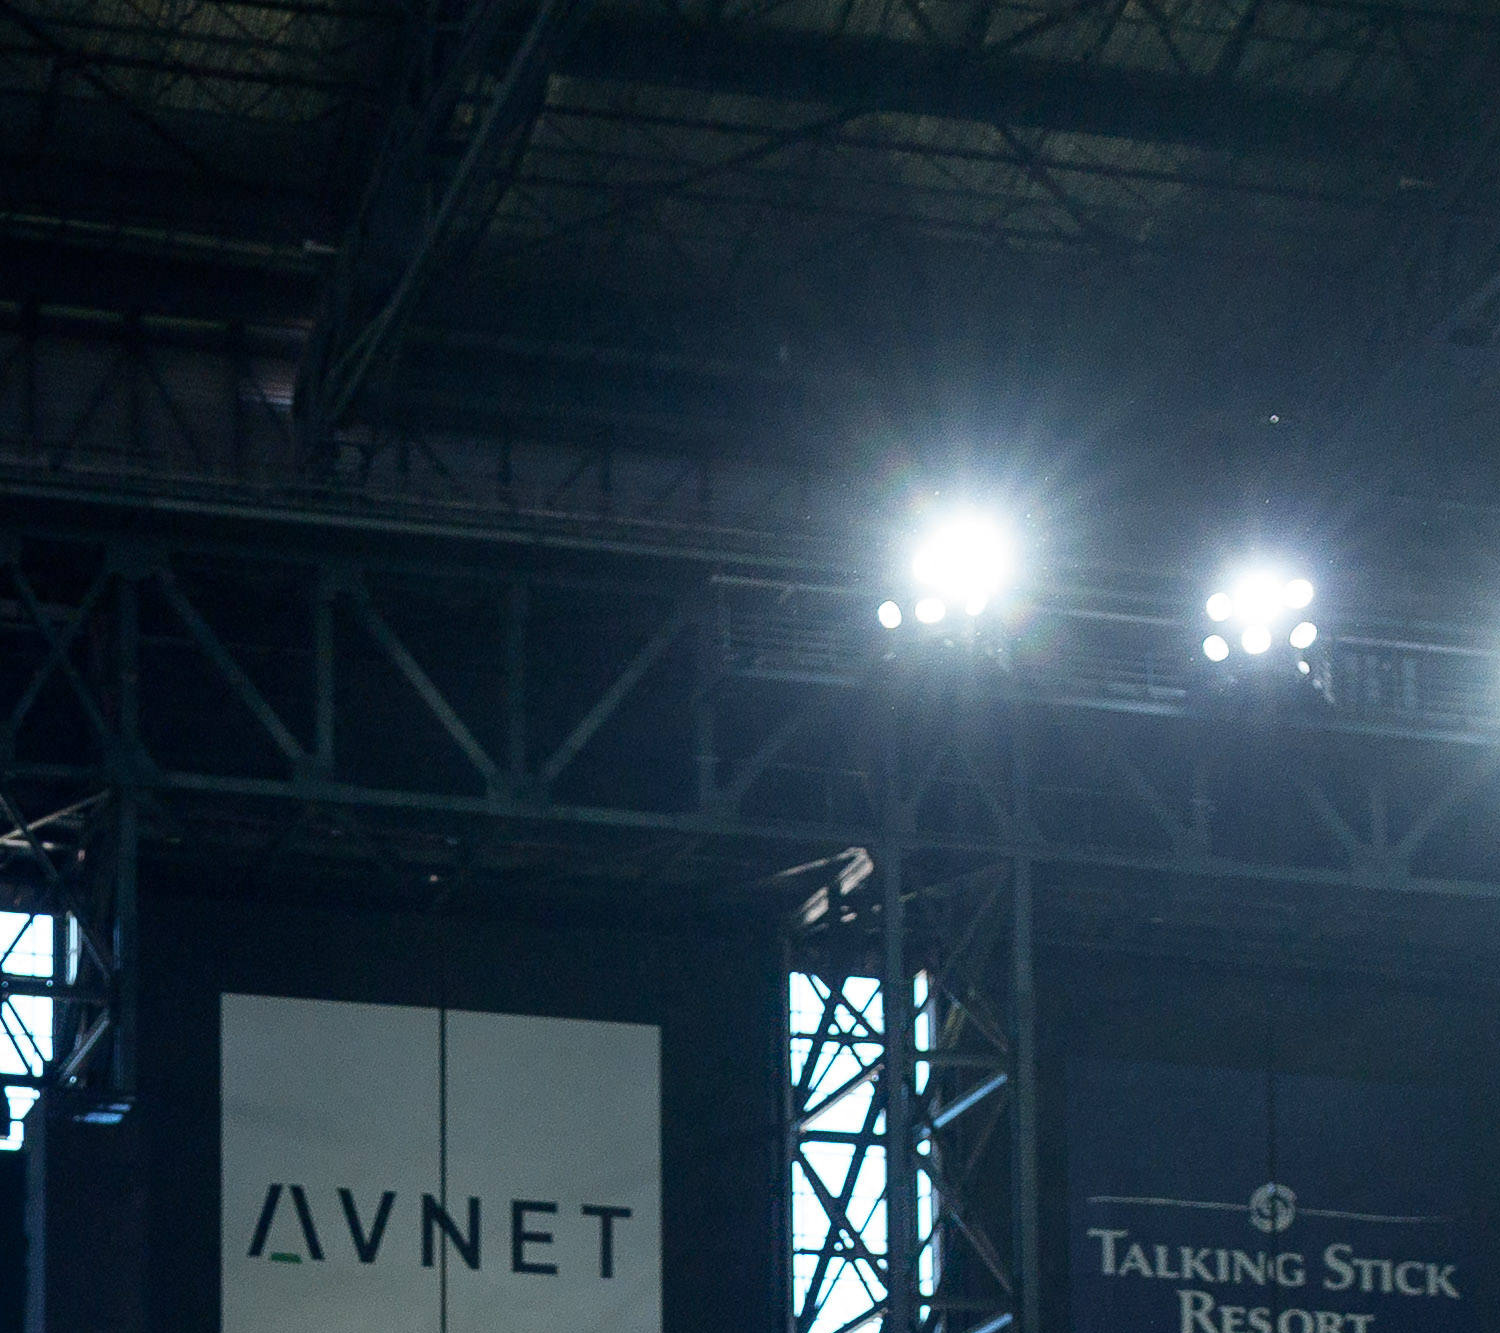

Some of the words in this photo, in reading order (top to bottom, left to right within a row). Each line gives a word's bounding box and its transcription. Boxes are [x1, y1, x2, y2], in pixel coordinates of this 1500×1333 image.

[246, 1183, 633, 1281] AVNET
[1087, 1228, 1306, 1290] TALKING
[1321, 1241, 1460, 1300] STICK
